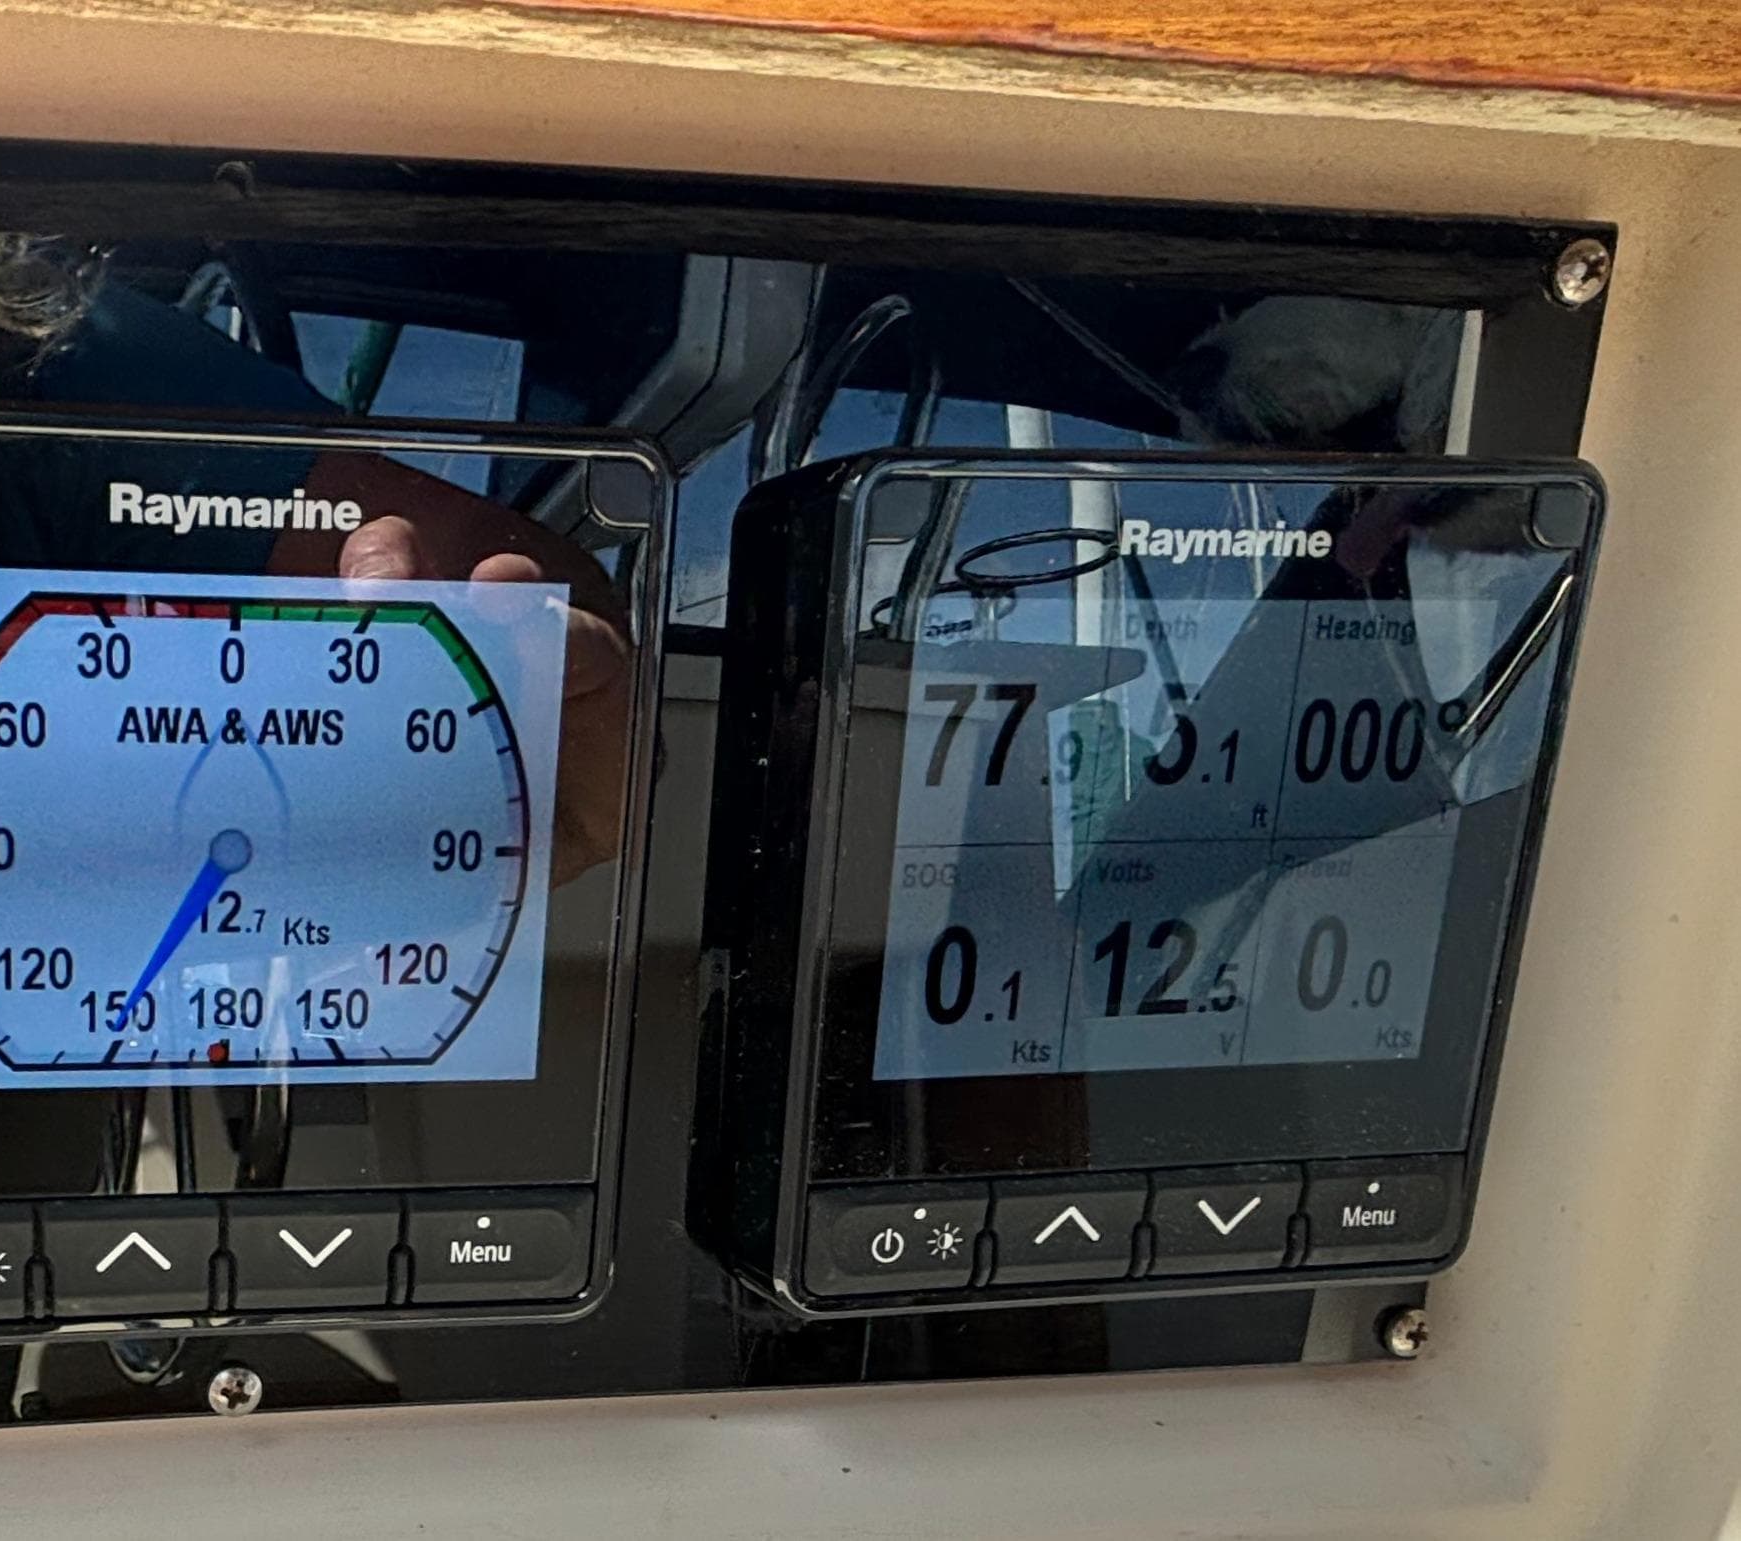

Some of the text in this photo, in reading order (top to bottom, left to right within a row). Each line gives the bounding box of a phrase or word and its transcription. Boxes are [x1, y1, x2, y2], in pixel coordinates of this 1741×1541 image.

[109, 483, 362, 534] Raymarine
[1120, 519, 1332, 565] Raymarine
[1316, 614, 1416, 646] Heading
[77, 633, 131, 680] 30
[220, 638, 245, 684] 0
[328, 637, 380, 684] 30
[117, 706, 345, 746] AWA & AWS
[406, 706, 457, 754] 60
[1252, 802, 1268, 828] ft
[433, 829, 483, 872] 90
[1097, 858, 1155, 883] Volts
[902, 862, 959, 889] SOG
[283, 917, 331, 946] Kts
[376, 943, 448, 986] 120
[924, 925, 1022, 1026] 0.1
[1093, 918, 1239, 1018] 12.5
[1296, 914, 1392, 1012] 0.0
[81, 991, 156, 1034] 150
[188, 987, 264, 1030] 180
[297, 989, 369, 1031] 150
[1011, 1039, 1051, 1064] Kts
[1342, 1206, 1395, 1229] Menu
[450, 1239, 512, 1264] Menu
